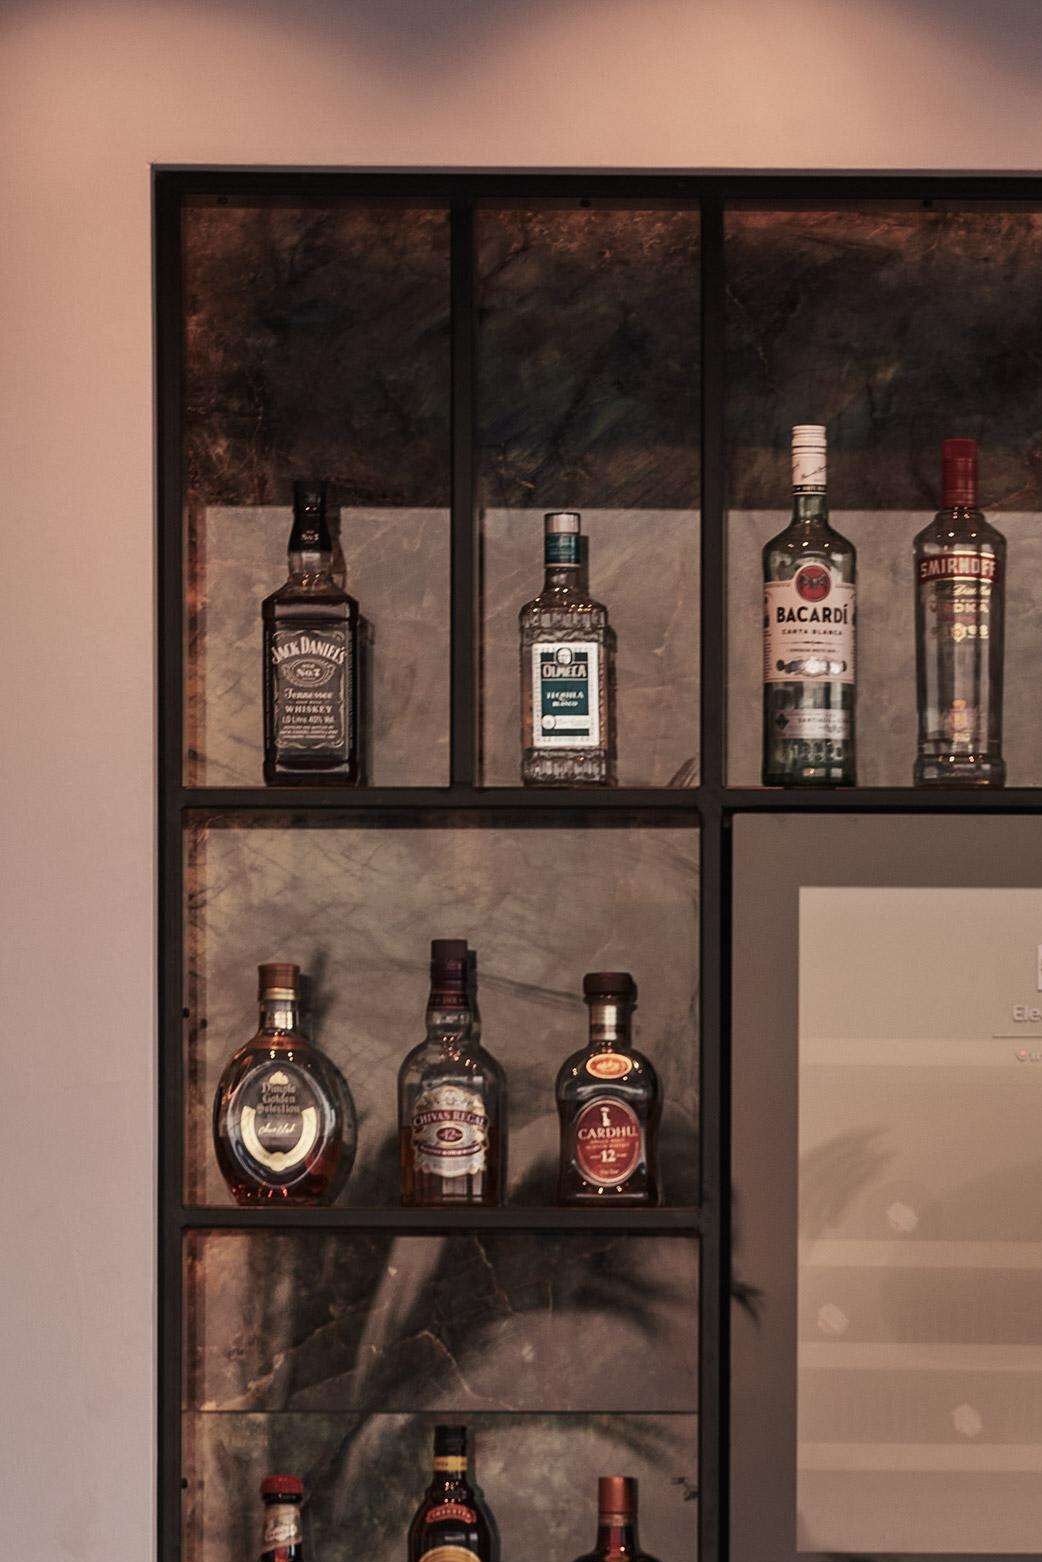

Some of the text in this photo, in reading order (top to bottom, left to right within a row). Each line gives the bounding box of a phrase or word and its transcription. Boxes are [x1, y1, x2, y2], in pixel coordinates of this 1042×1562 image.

[920, 557, 996, 578] SMIRNOFF
[777, 604, 848, 625] BACARDÍ
[271, 636, 348, 665] JACK DANIEL'S
[543, 665, 587, 678] OLMECA
[285, 705, 332, 713] WHISKEY
[413, 1111, 485, 1126] CHIVAS REGAL
[577, 1126, 639, 1140] CARDHU
[601, 1149, 616, 1163] 12
